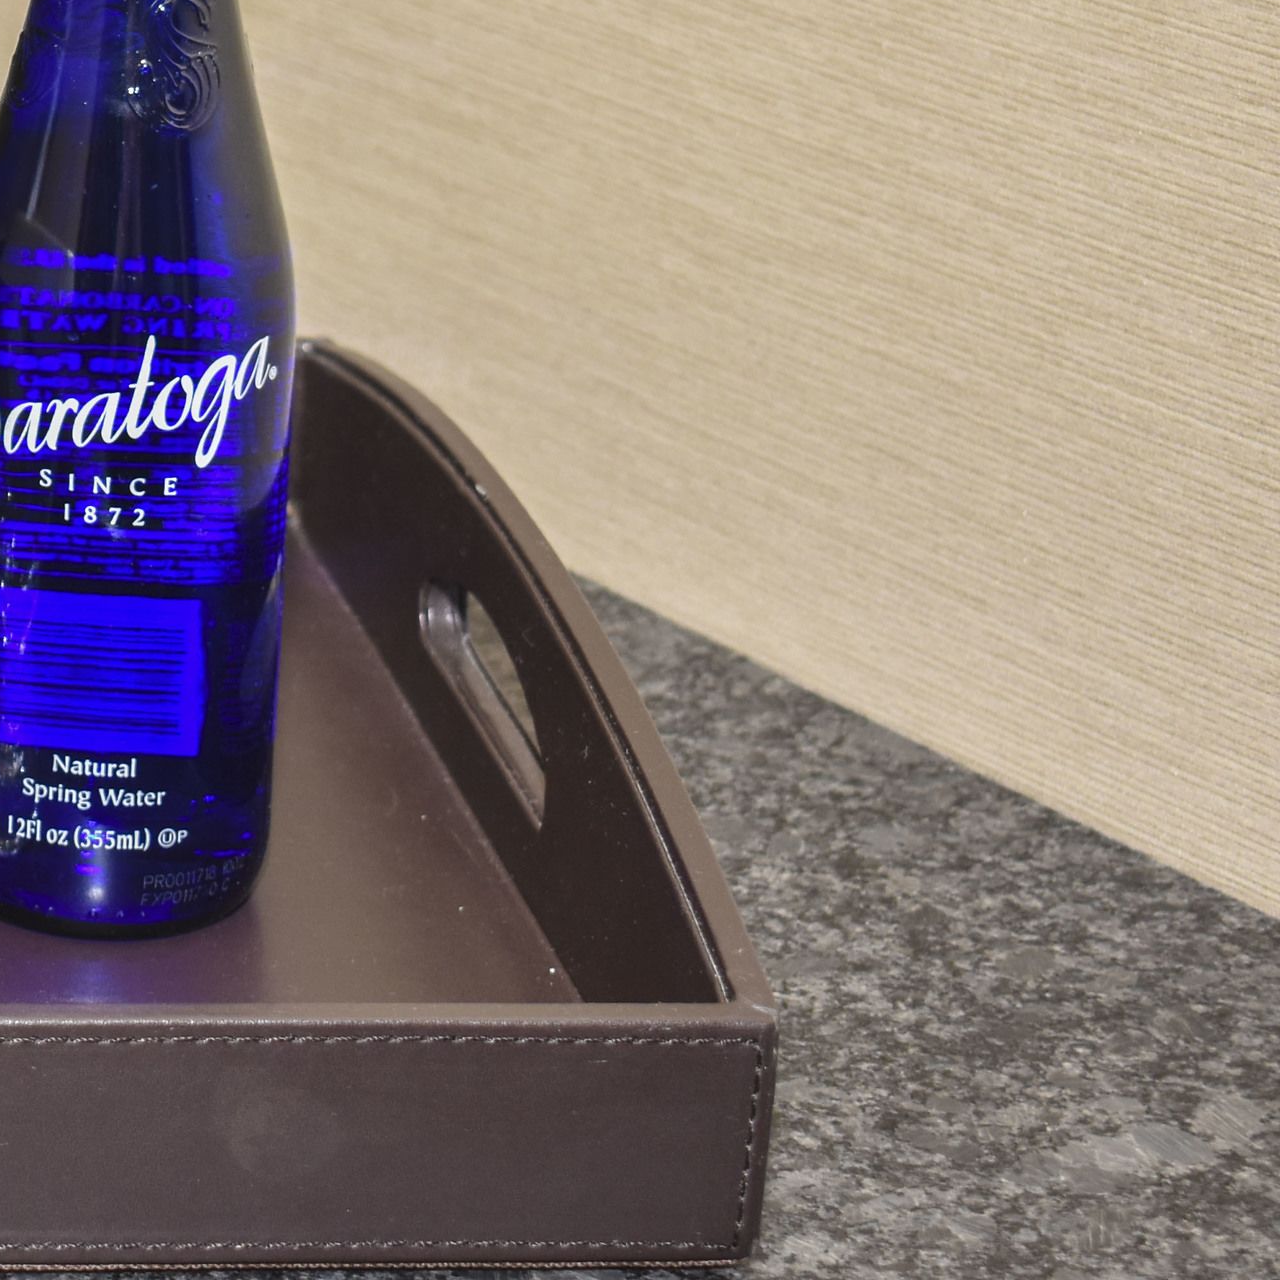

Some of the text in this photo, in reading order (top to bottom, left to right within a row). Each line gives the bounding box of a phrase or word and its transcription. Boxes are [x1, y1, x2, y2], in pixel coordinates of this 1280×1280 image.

[39, 468, 178, 496] SINCE
[63, 504, 146, 528] 1872
[52, 754, 137, 778] Natural
[22, 778, 166, 809] Spring Water
[46, 829, 69, 846] oz
[74, 826, 151, 852] (355mL)
